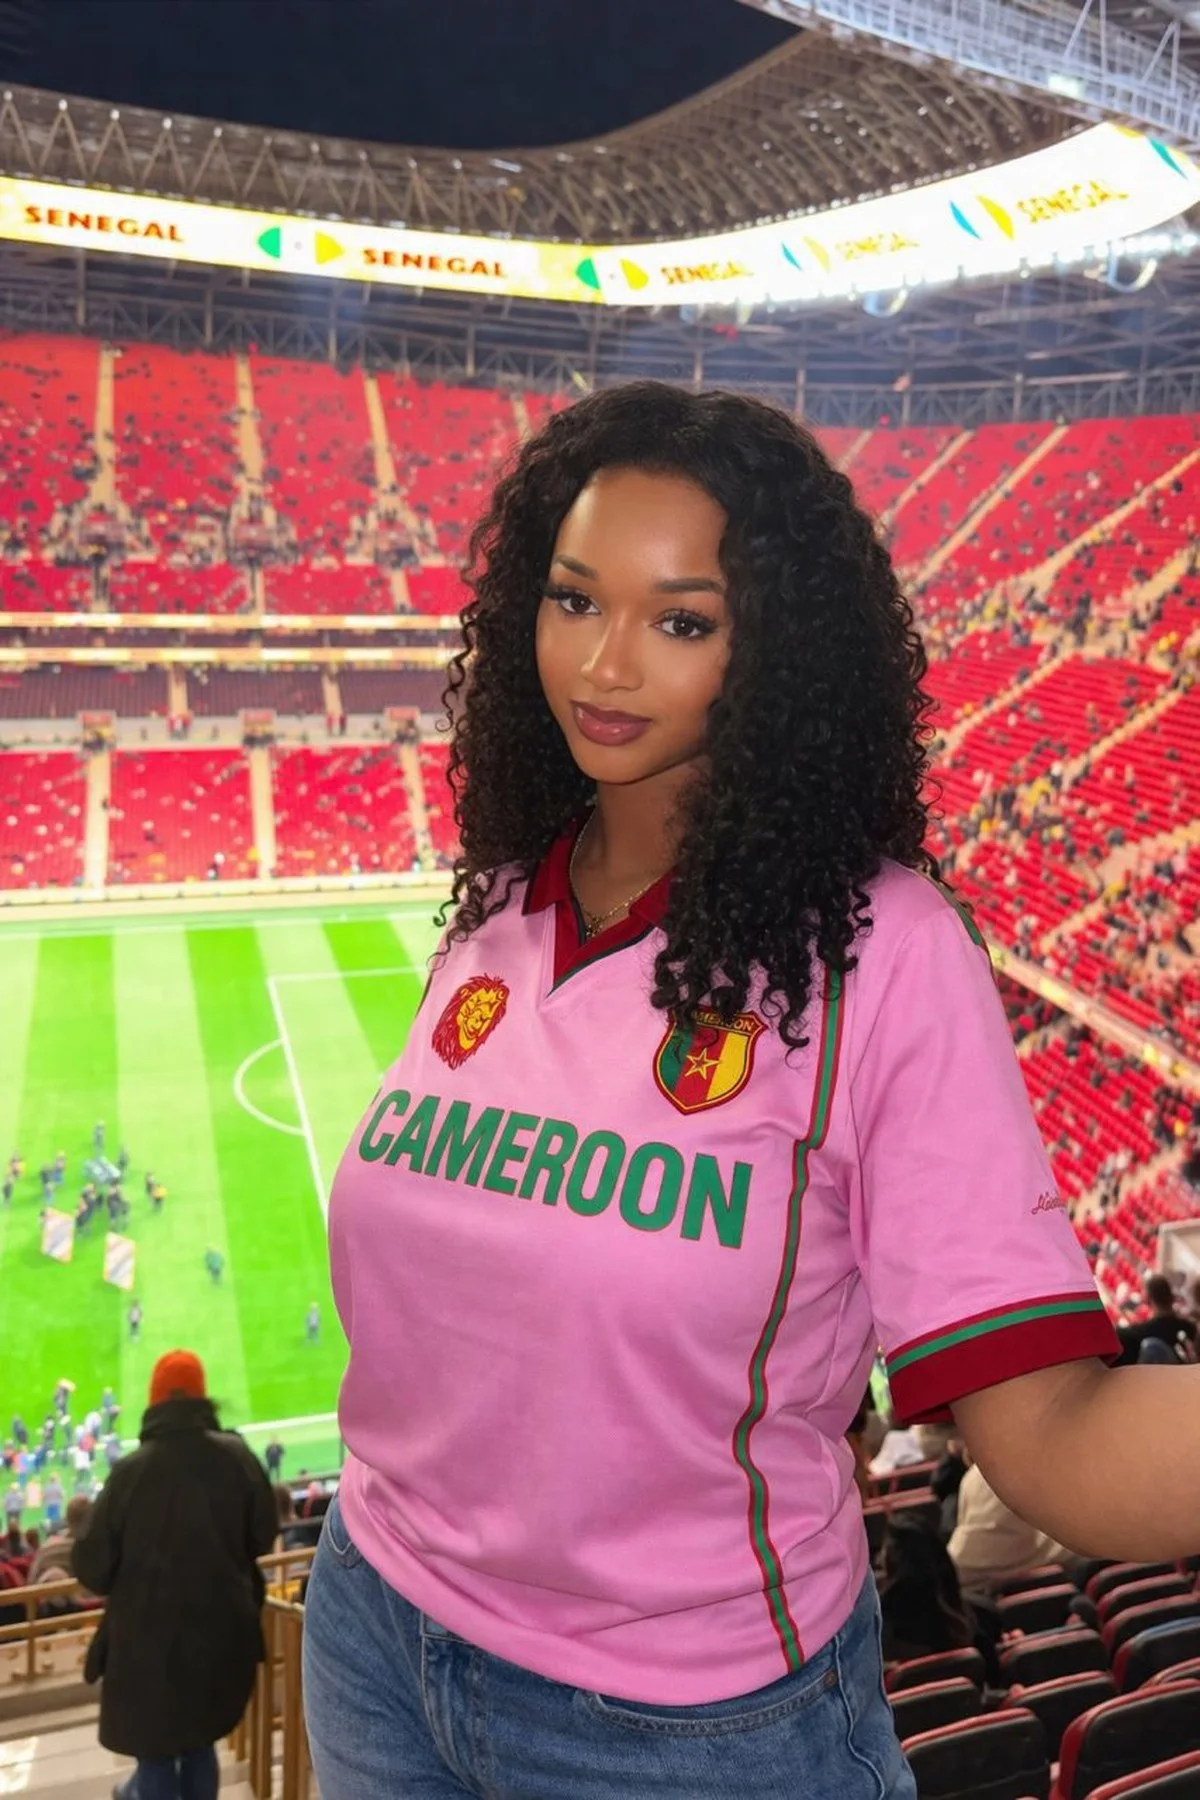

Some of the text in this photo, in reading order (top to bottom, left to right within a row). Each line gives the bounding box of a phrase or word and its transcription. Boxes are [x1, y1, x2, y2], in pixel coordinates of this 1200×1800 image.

[25, 205, 184, 243] SENEGAL
[363, 248, 507, 278] SENEGAL
[358, 1089, 753, 1249] CAMEROON
